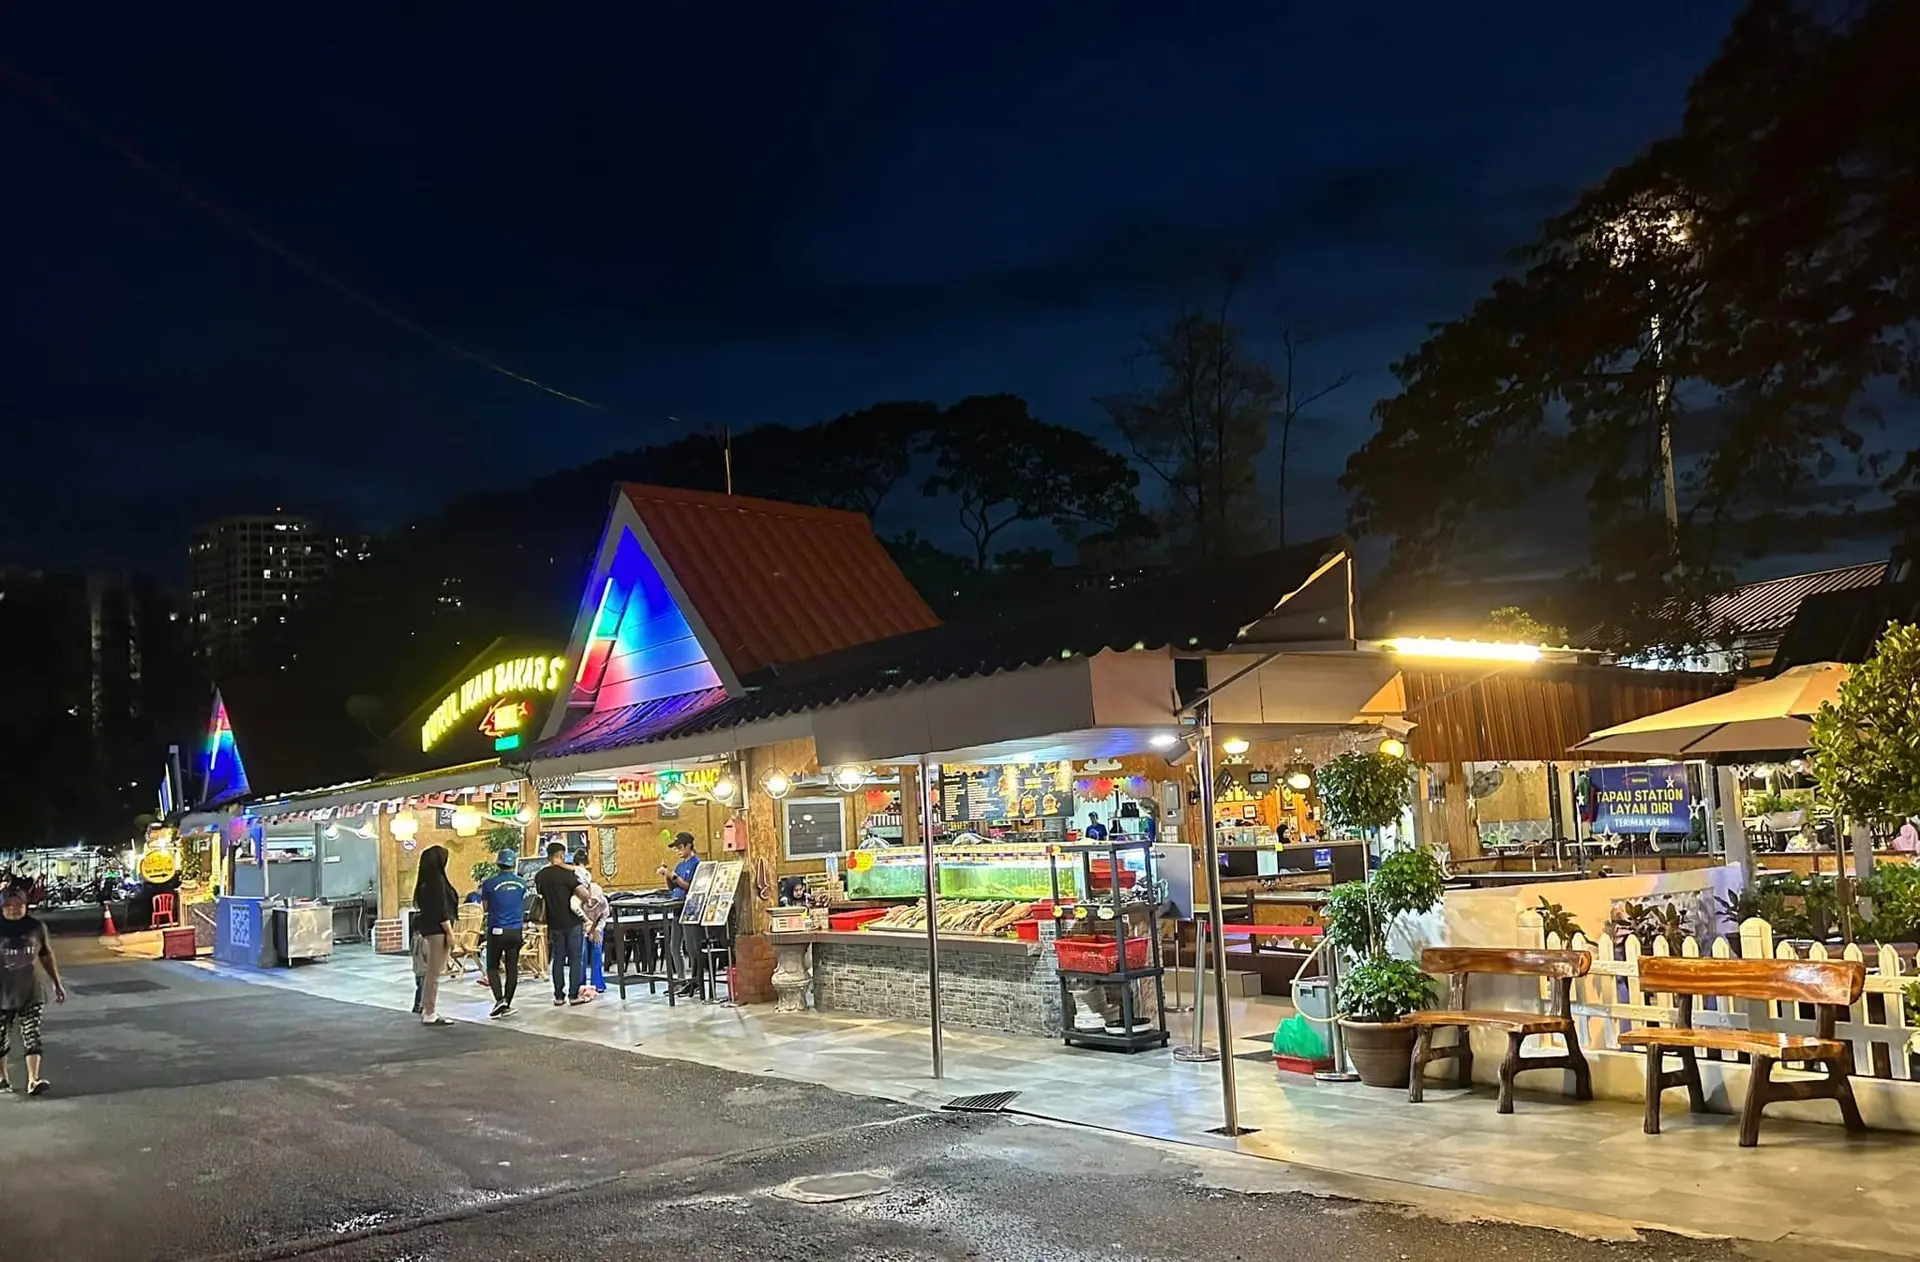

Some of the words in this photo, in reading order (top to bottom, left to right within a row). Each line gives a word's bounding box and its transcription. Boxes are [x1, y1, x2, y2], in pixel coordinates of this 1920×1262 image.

[461, 667, 494, 714] IKAN
[494, 656, 546, 695] BAKAR
[1597, 791, 1632, 803] TAPAU
[1634, 788, 1684, 802] STATION
[1610, 803, 1648, 815] LAYAN
[1651, 802, 1673, 814] DIRI
[1615, 818, 1645, 827] TERIMA
[1645, 817, 1670, 827] KASIH
